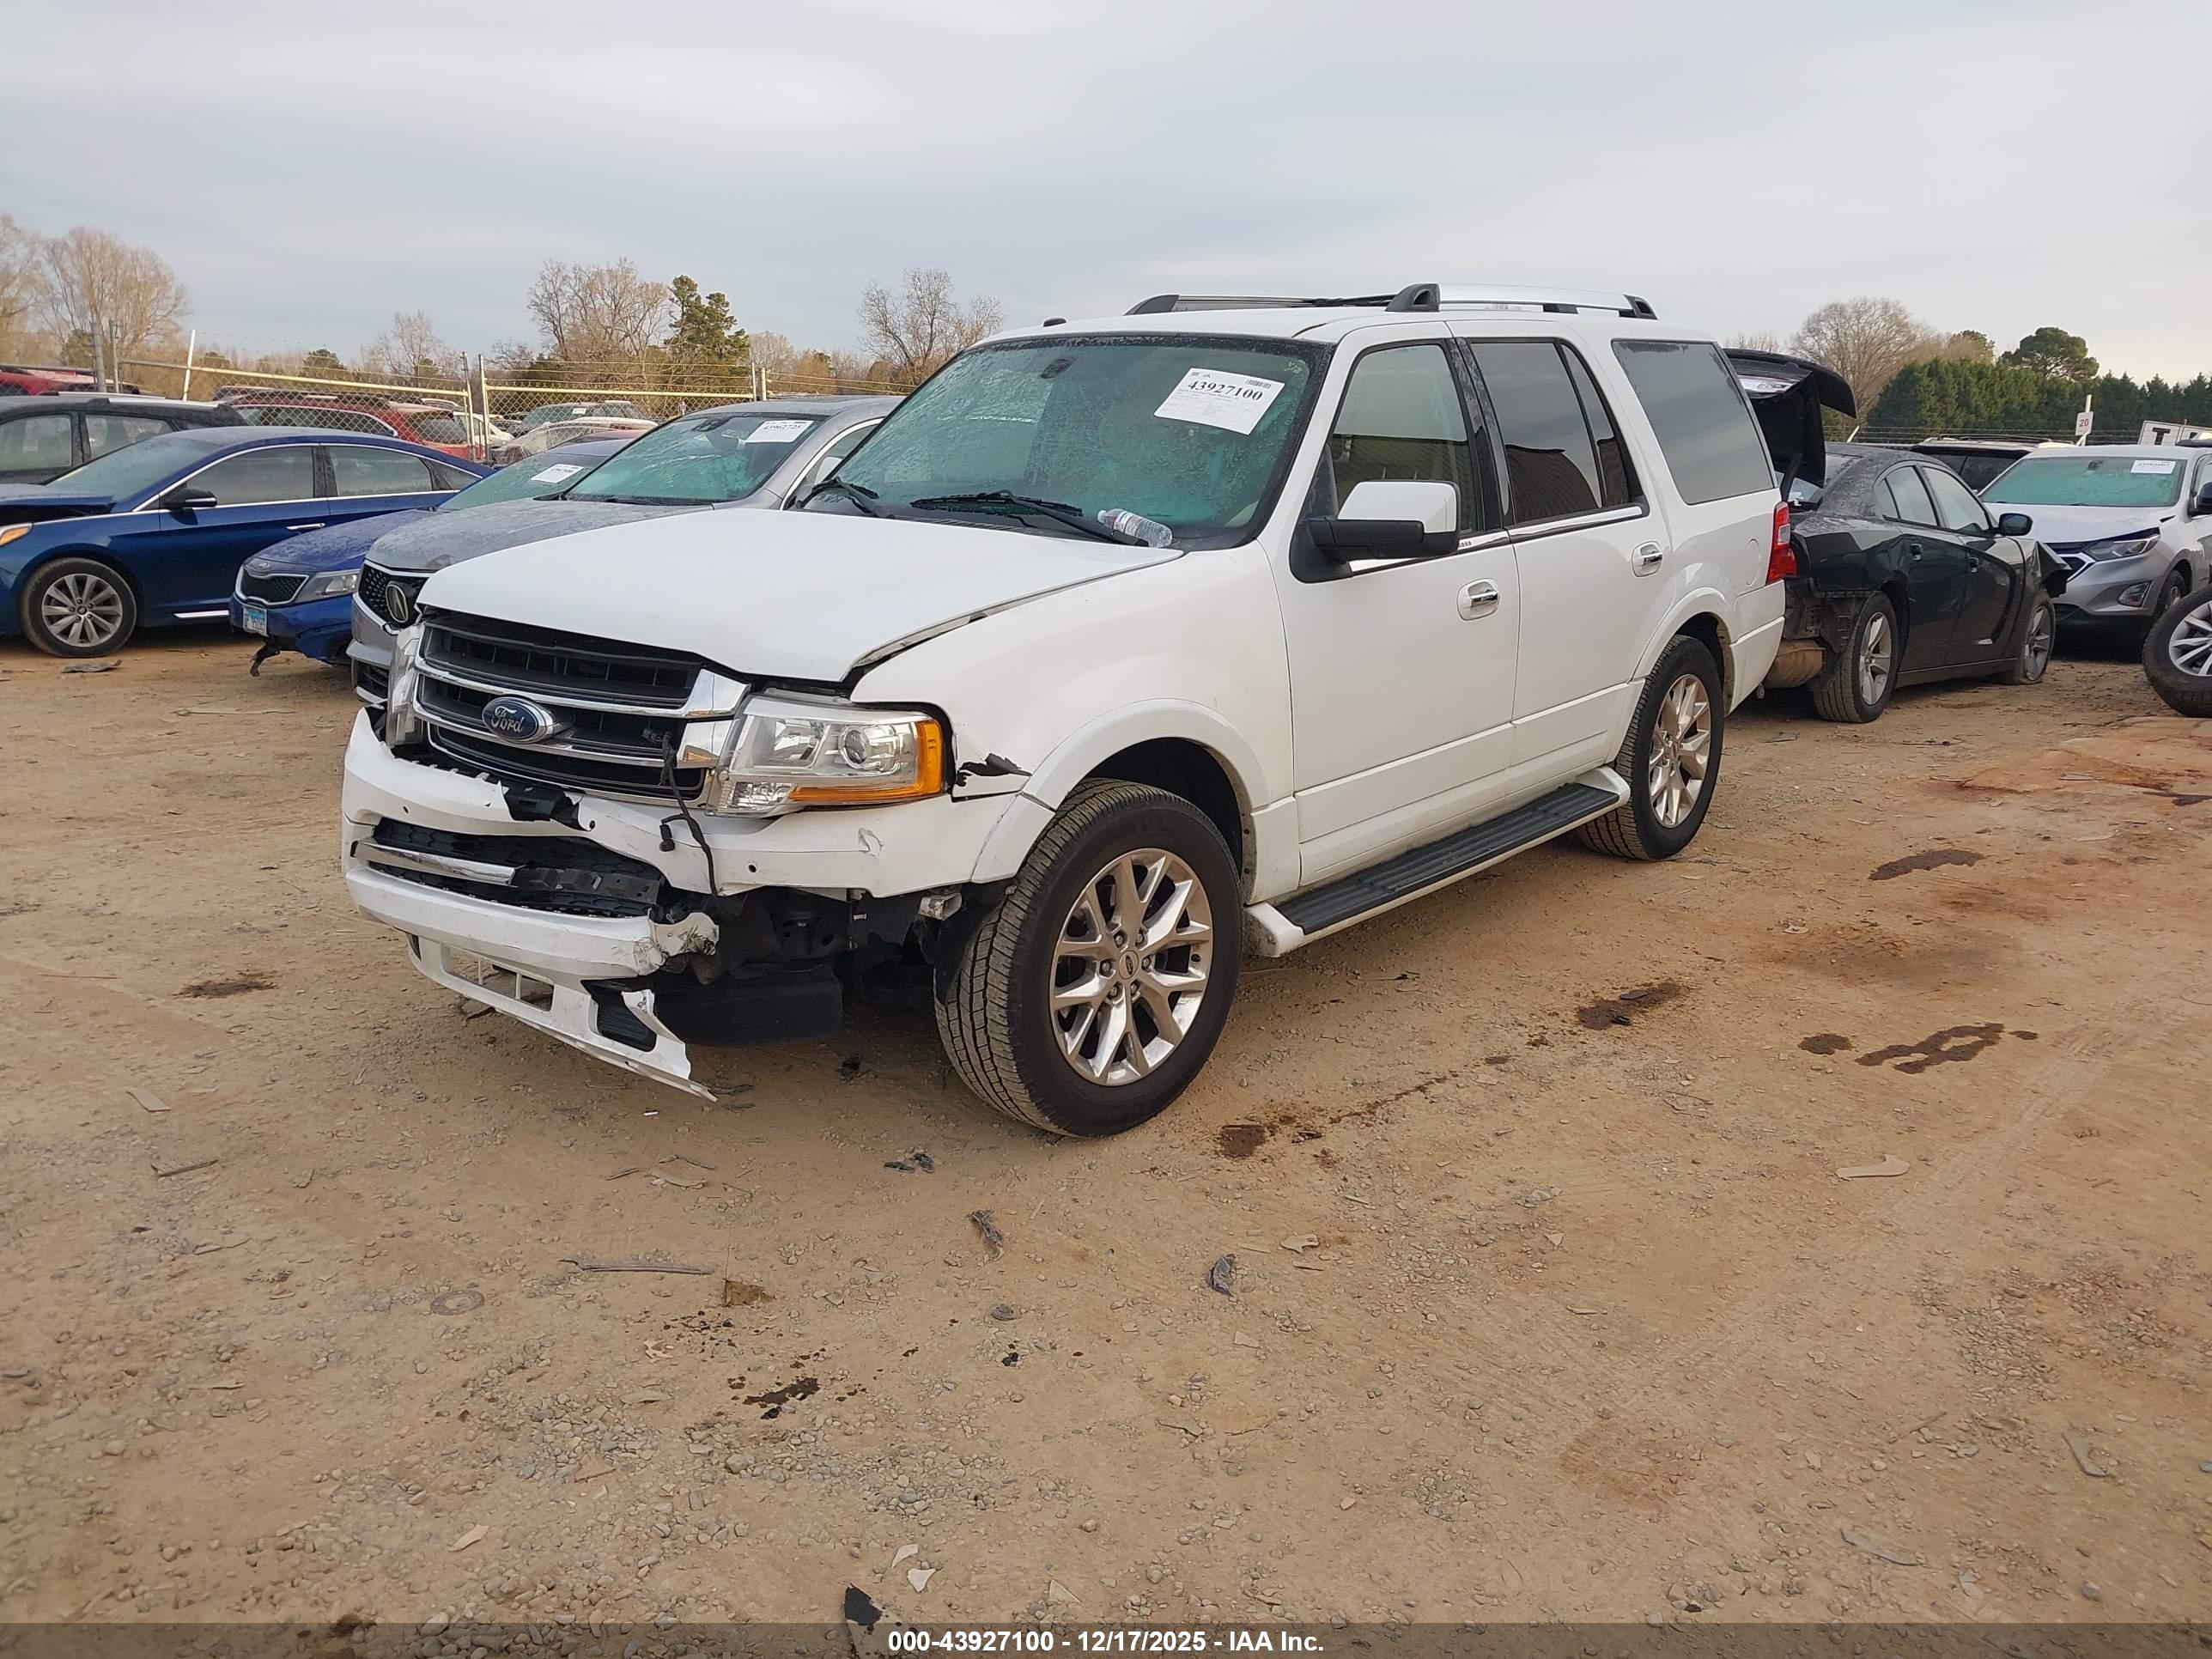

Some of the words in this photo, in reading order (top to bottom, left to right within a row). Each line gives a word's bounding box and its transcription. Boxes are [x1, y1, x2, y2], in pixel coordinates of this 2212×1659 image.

[1188, 380, 1263, 401] 43927100
[2079, 418, 2089, 428] 20
[490, 705, 526, 733] Ford
